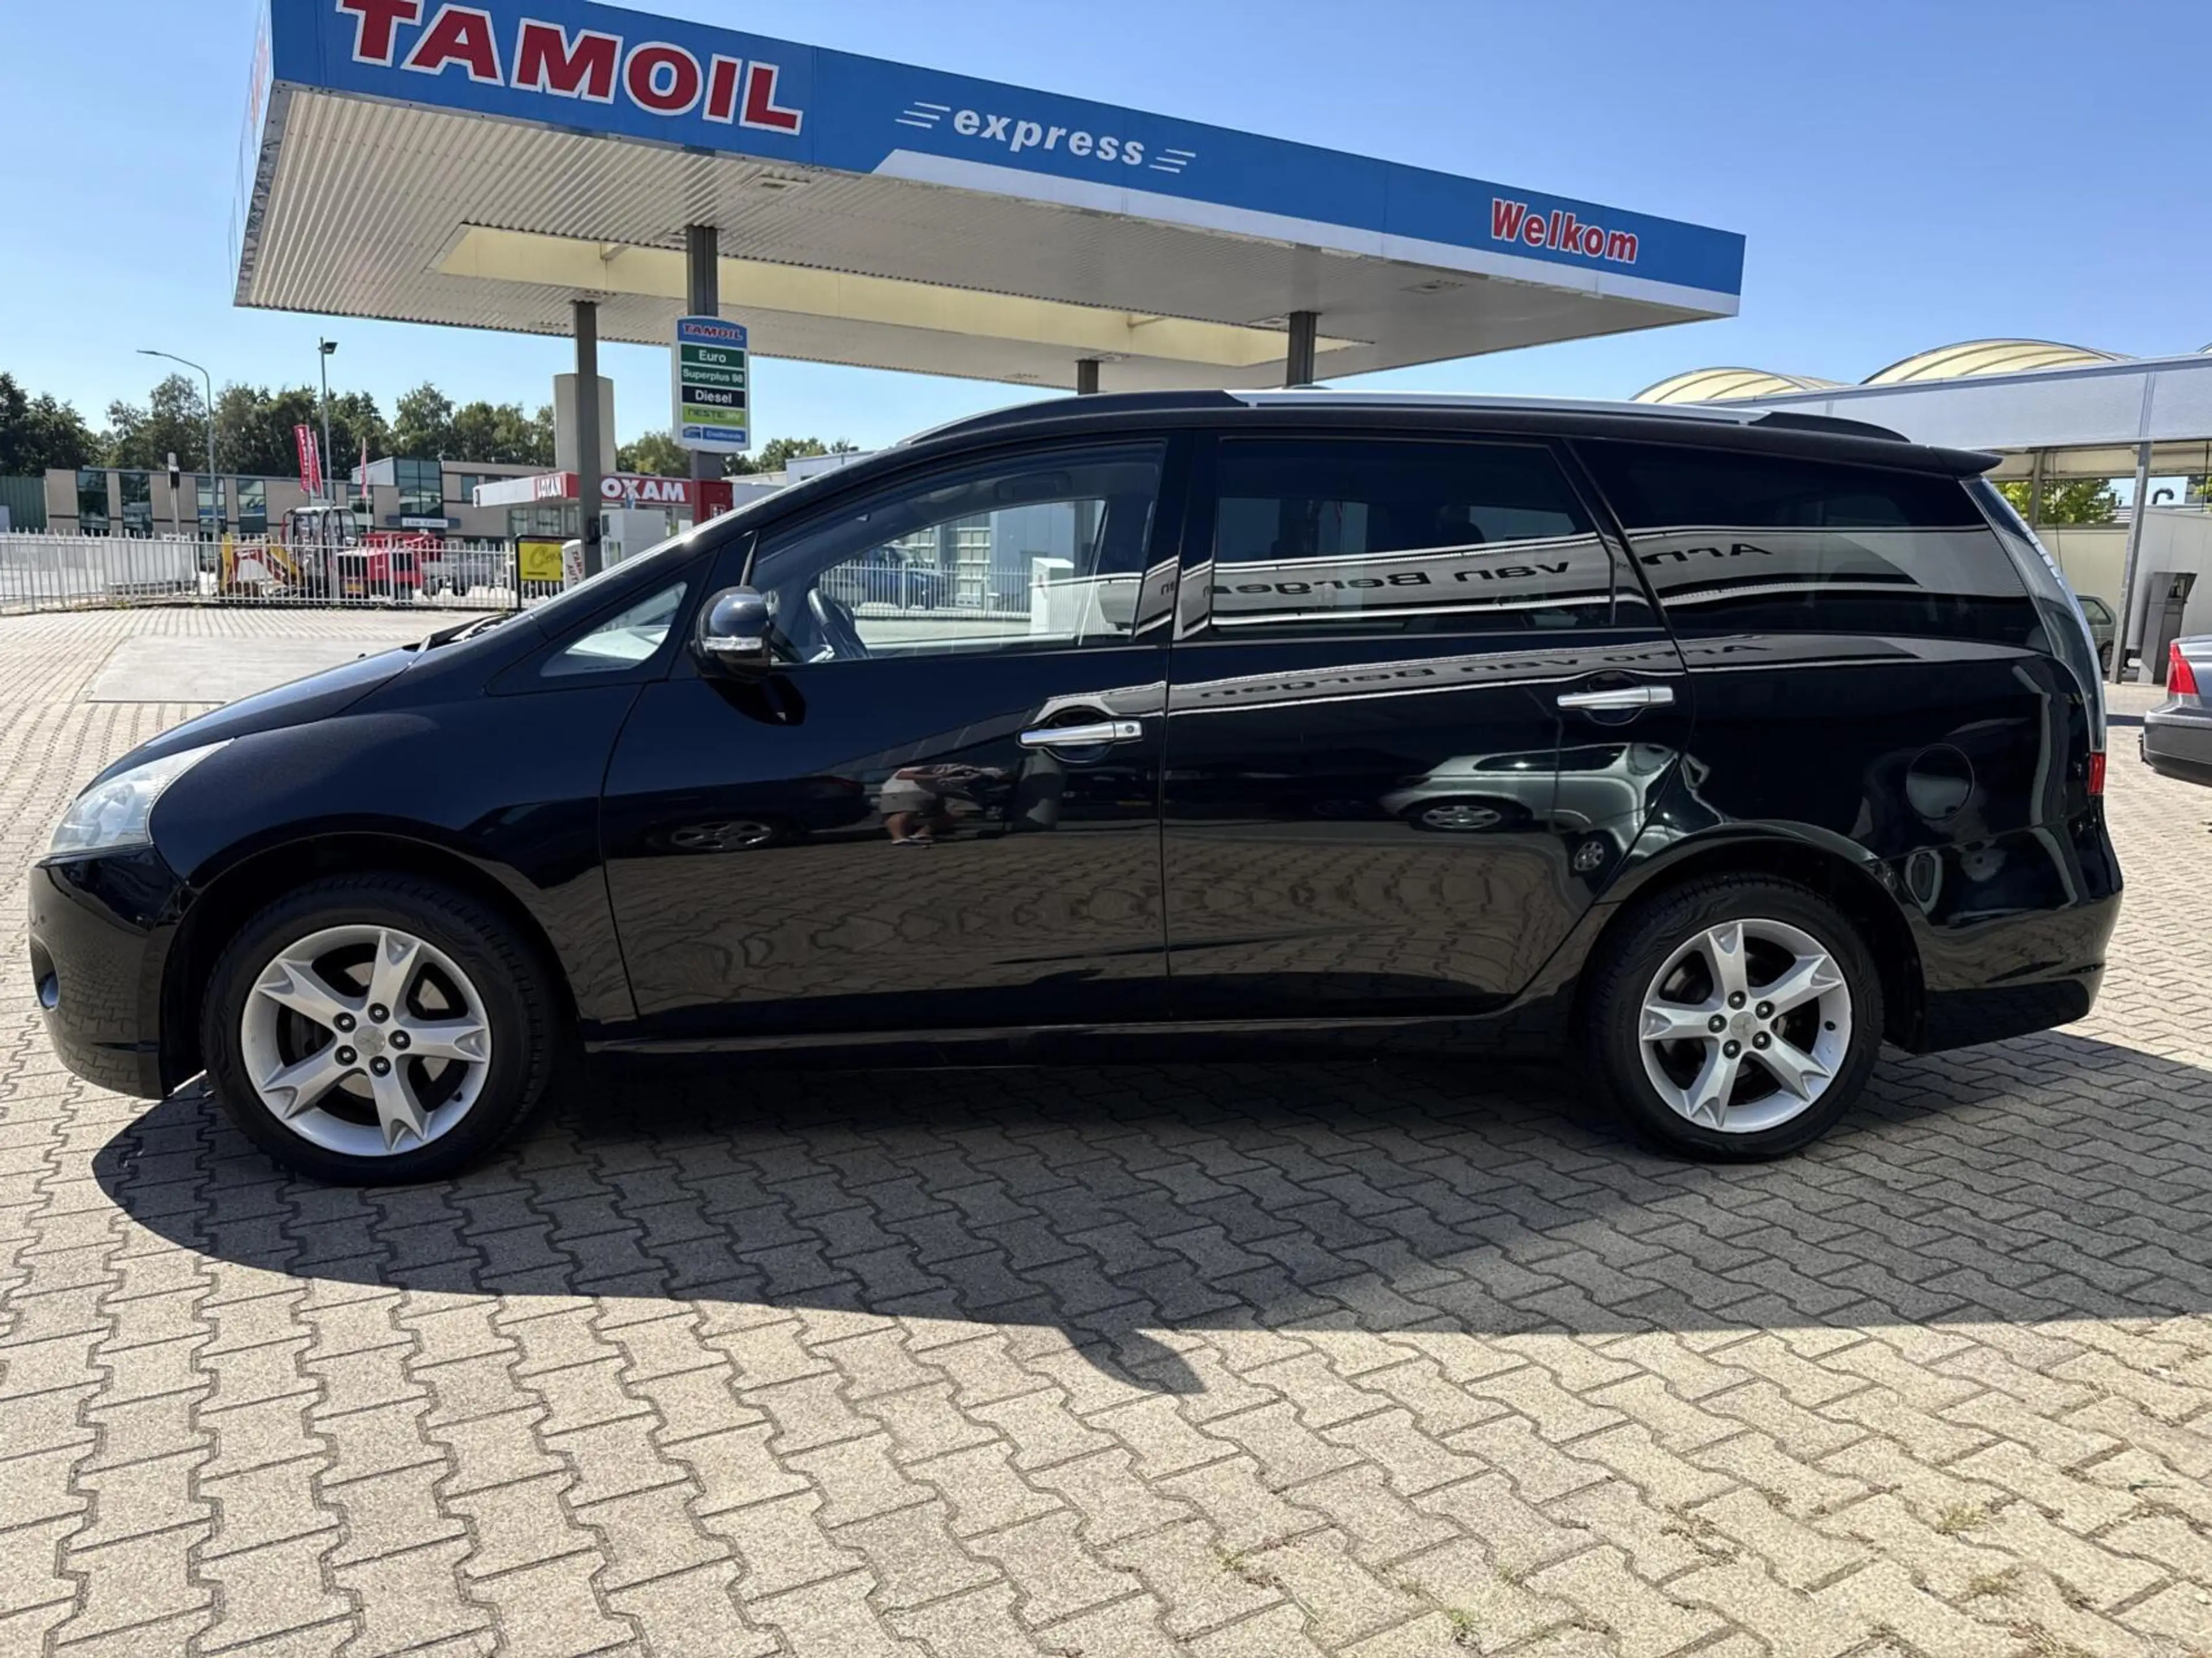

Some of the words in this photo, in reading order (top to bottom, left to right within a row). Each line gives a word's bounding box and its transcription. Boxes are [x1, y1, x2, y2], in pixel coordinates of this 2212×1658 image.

[336, 0, 803, 135] TAMOIL
[953, 107, 1145, 166] express
[1491, 198, 1638, 265] Welkom
[683, 324, 743, 340] TAMOIL
[698, 350, 726, 363] Euro
[683, 369, 730, 382] Superplus
[695, 390, 732, 404] Diesel
[601, 476, 686, 502] OXAM
